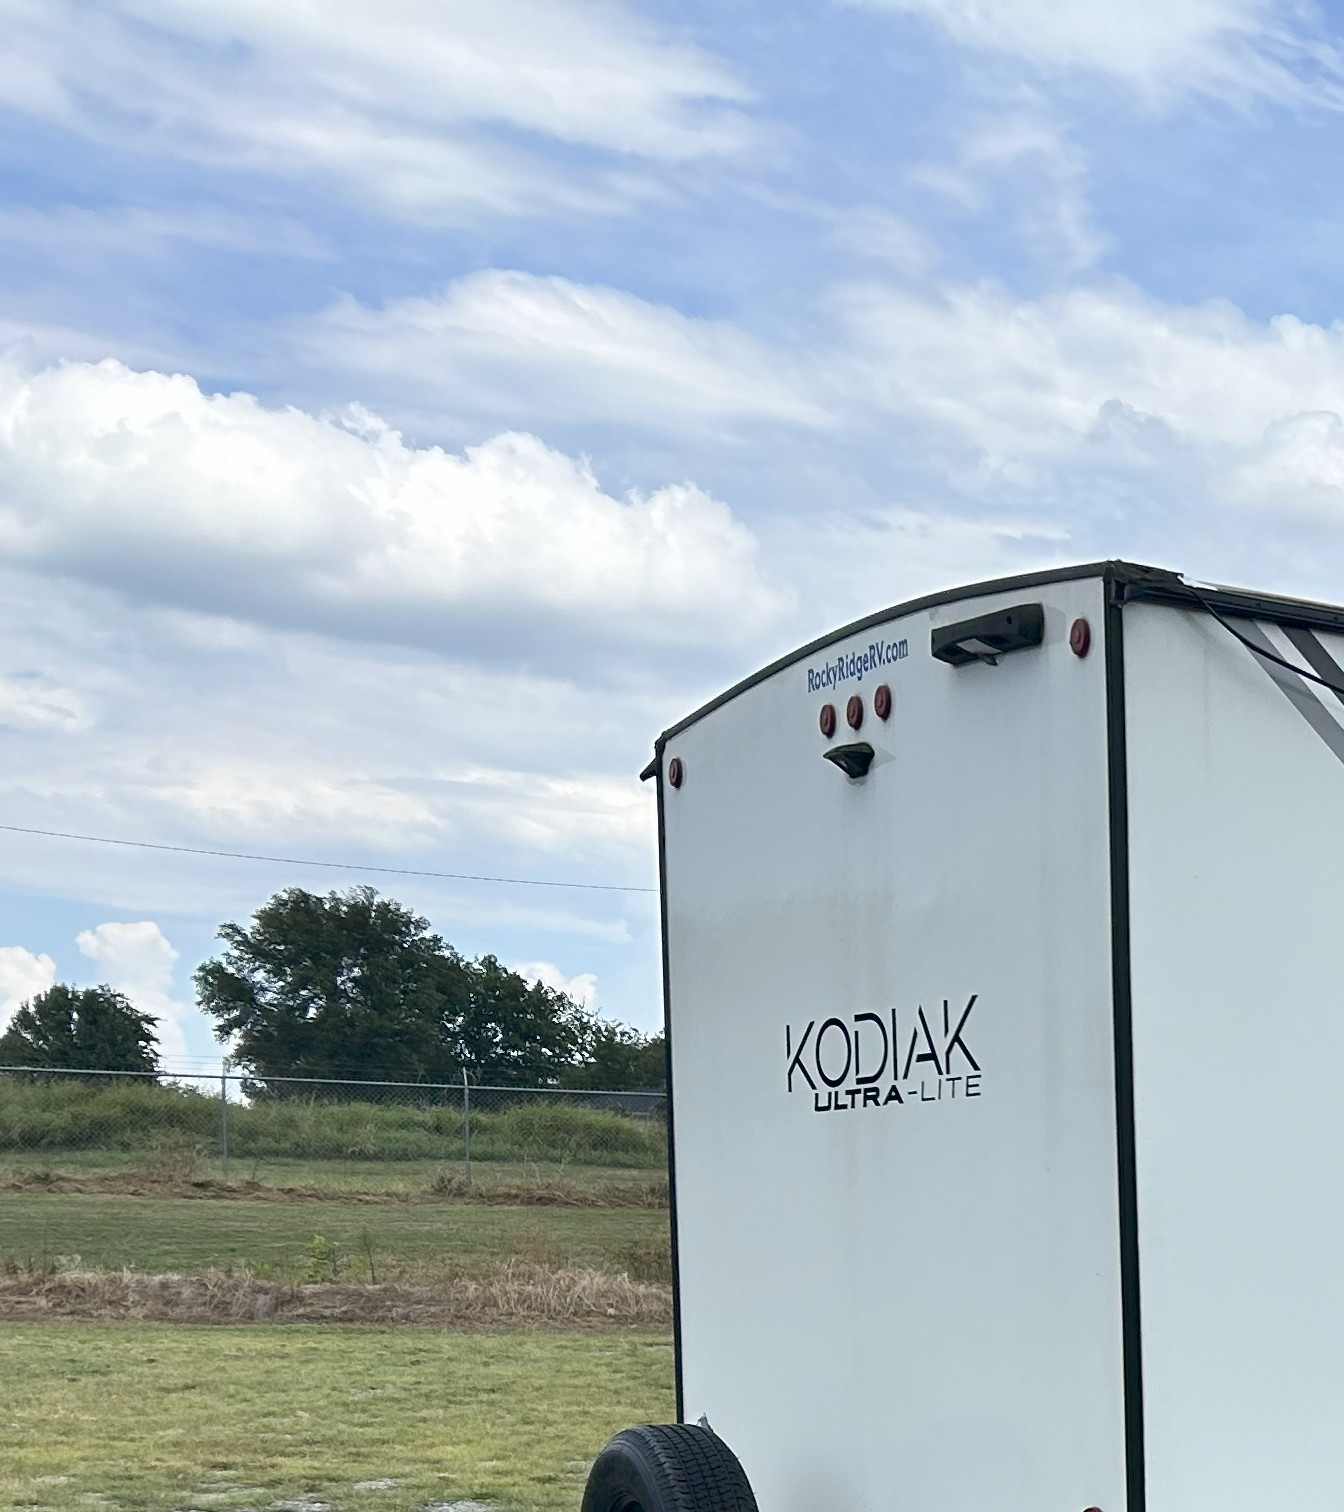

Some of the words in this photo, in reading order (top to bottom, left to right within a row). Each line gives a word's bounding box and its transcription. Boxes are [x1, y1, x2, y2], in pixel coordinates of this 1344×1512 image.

[807, 639, 909, 693] RockyRidgeRV.com
[786, 994, 981, 1093] KODIAK
[814, 1074, 982, 1112] ULTRA-LITE
